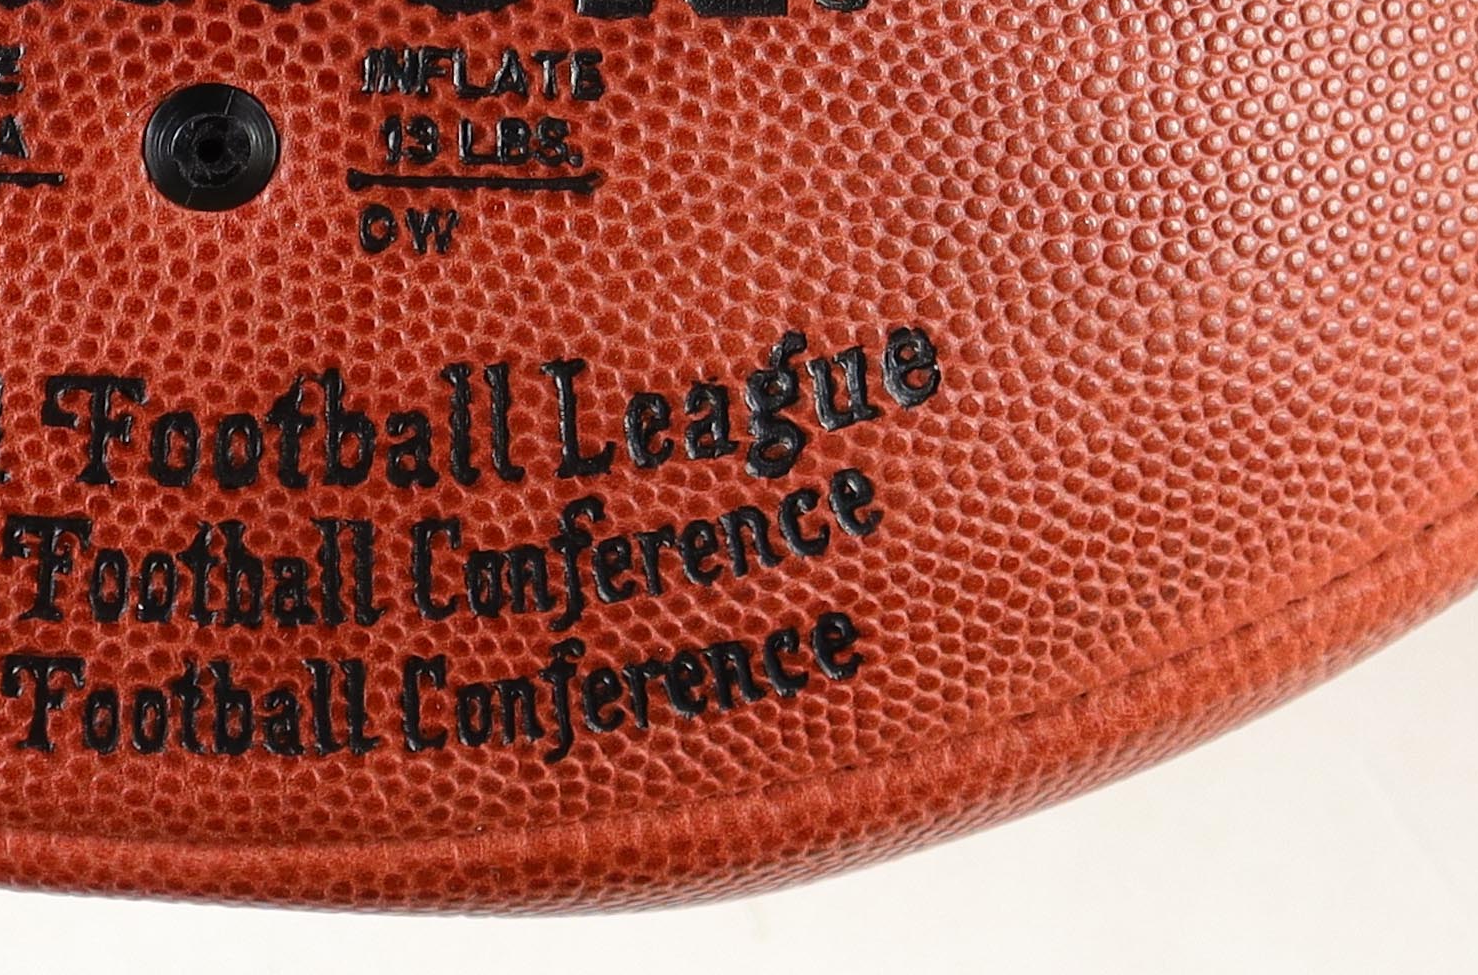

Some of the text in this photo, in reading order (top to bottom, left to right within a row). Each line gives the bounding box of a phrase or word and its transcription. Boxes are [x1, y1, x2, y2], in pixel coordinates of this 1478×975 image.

[361, 46, 605, 101] INFLATE
[380, 114, 584, 168] 13 LBS.
[40, 366, 525, 491] Football
[538, 326, 943, 481] League
[1, 513, 386, 628] Football
[411, 465, 885, 632] Conference
[0, 646, 382, 757] Football
[397, 609, 864, 765] Conference
